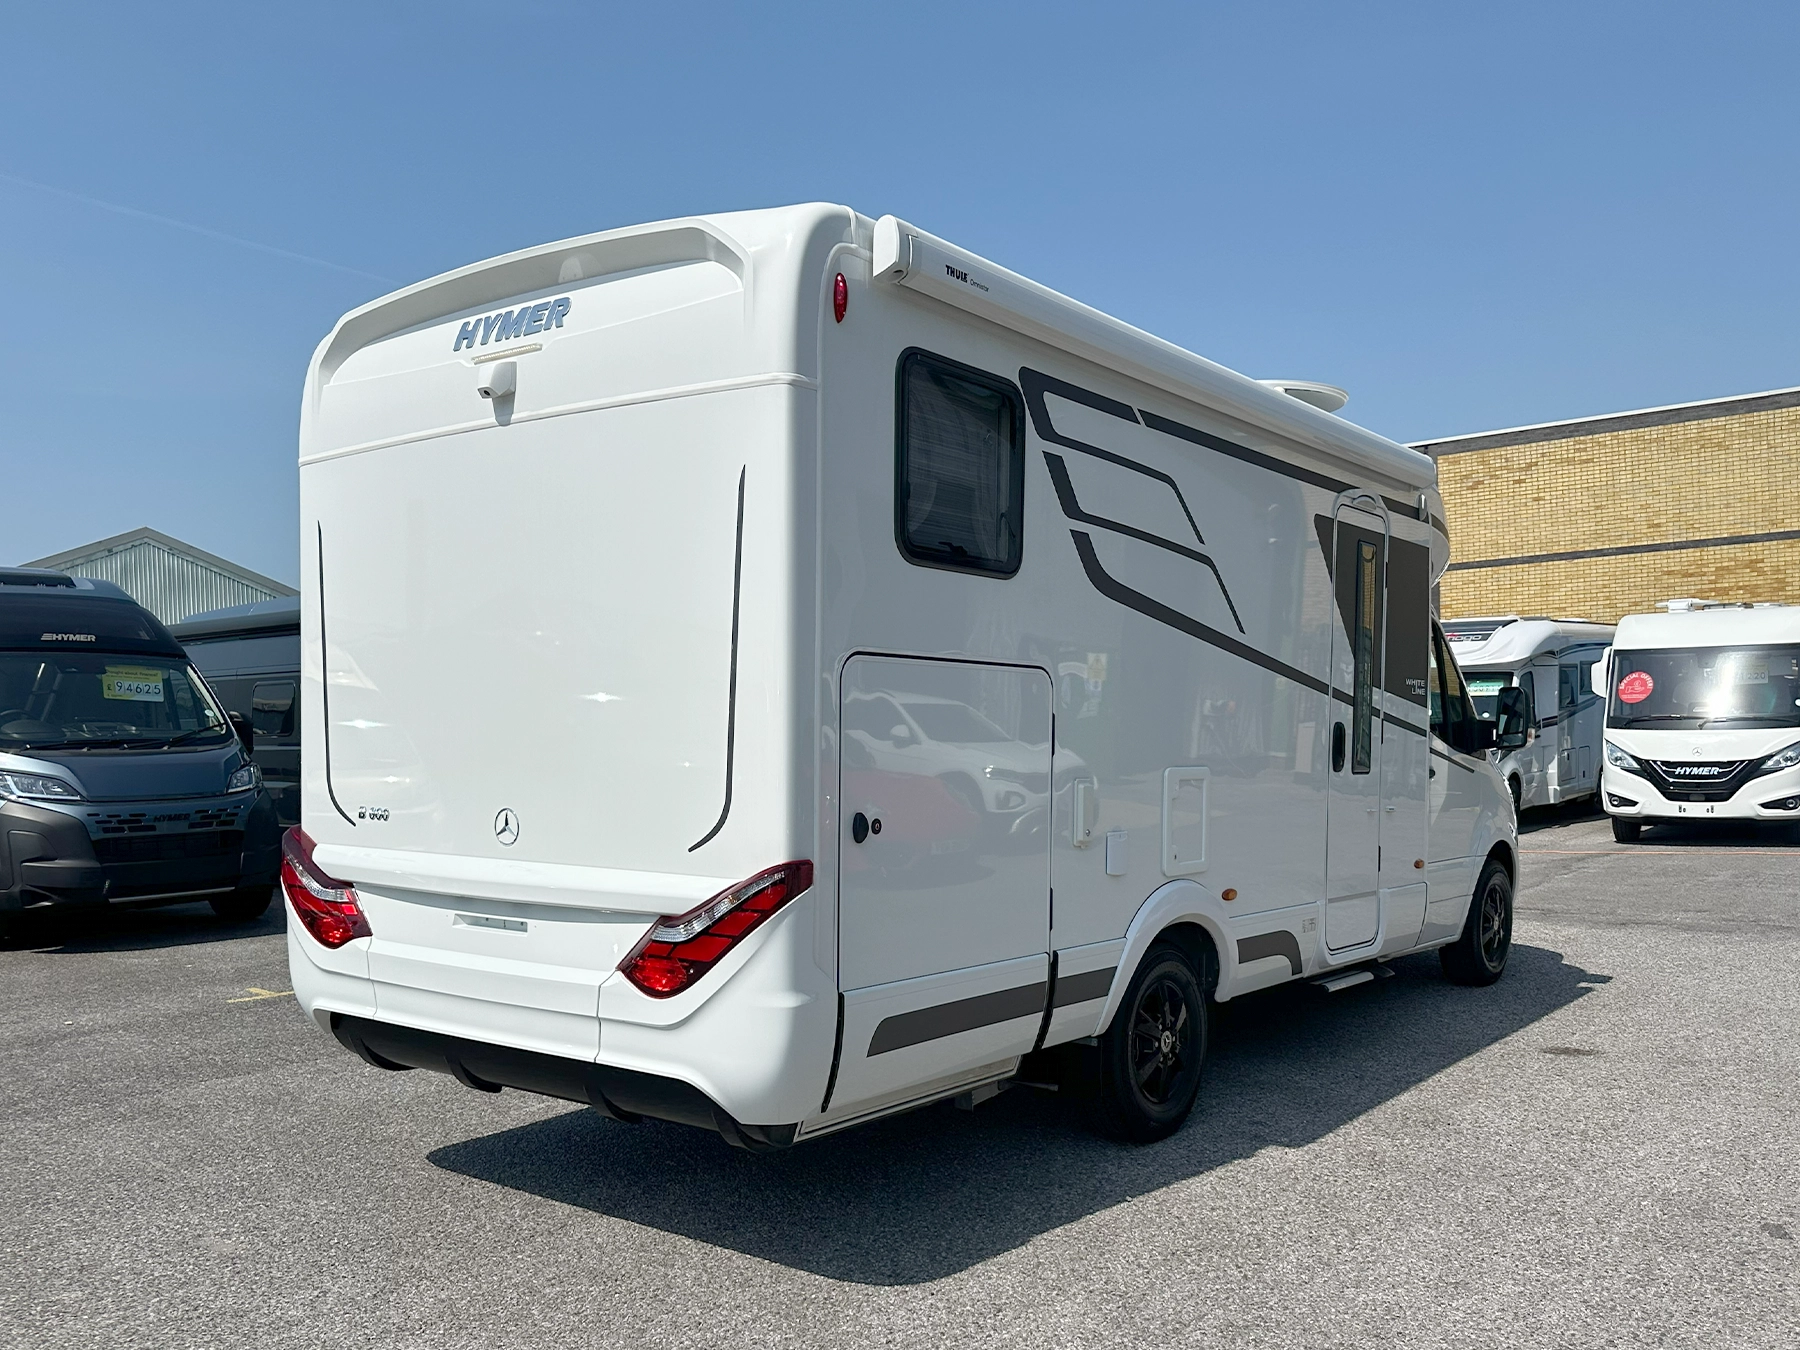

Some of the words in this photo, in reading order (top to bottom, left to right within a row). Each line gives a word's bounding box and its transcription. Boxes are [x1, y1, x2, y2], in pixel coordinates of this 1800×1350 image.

[945, 264, 968, 284] THULE
[452, 296, 572, 352] HYMER
[52, 633, 97, 642] HYMER
[1405, 678, 1426, 687] WHITE
[116, 681, 161, 695] 94625
[1411, 687, 1426, 696] LINE
[1674, 766, 1720, 775] HYMER
[153, 813, 191, 822] HYMER
